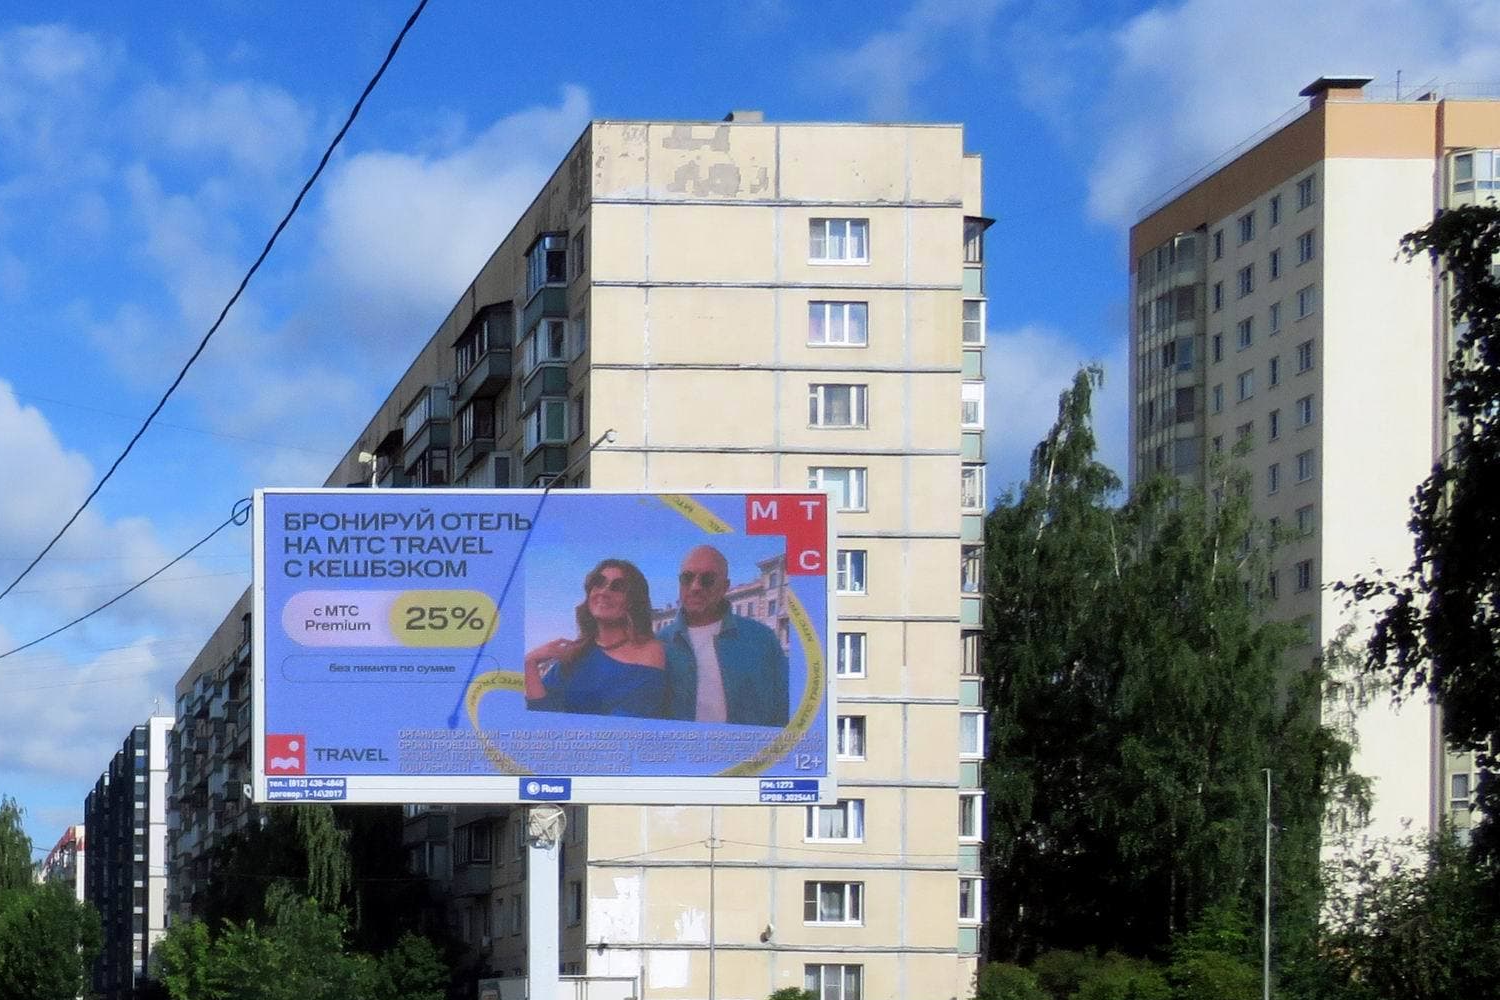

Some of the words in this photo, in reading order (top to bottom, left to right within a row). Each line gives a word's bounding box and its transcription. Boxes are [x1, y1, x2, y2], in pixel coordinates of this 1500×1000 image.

[284, 508, 434, 531] БРОНИРУЙ
[441, 512, 532, 531] ОТЕЛЬ
[284, 537, 322, 554] НА
[327, 537, 385, 554] МТС
[390, 537, 493, 554] TRAVEL
[284, 560, 302, 578] С
[308, 560, 467, 578] КЕШБЭКОМ
[313, 608, 322, 616] с
[325, 605, 359, 616] МТС
[305, 619, 371, 631] Premium
[405, 606, 485, 631] 25%
[329, 663, 350, 673] без
[353, 664, 397, 673] лимита
[400, 665, 414, 673] по
[417, 665, 456, 673] сумме
[314, 748, 389, 762] TRAVEL
[795, 754, 822, 771] 12+
[541, 783, 564, 793] Russ
